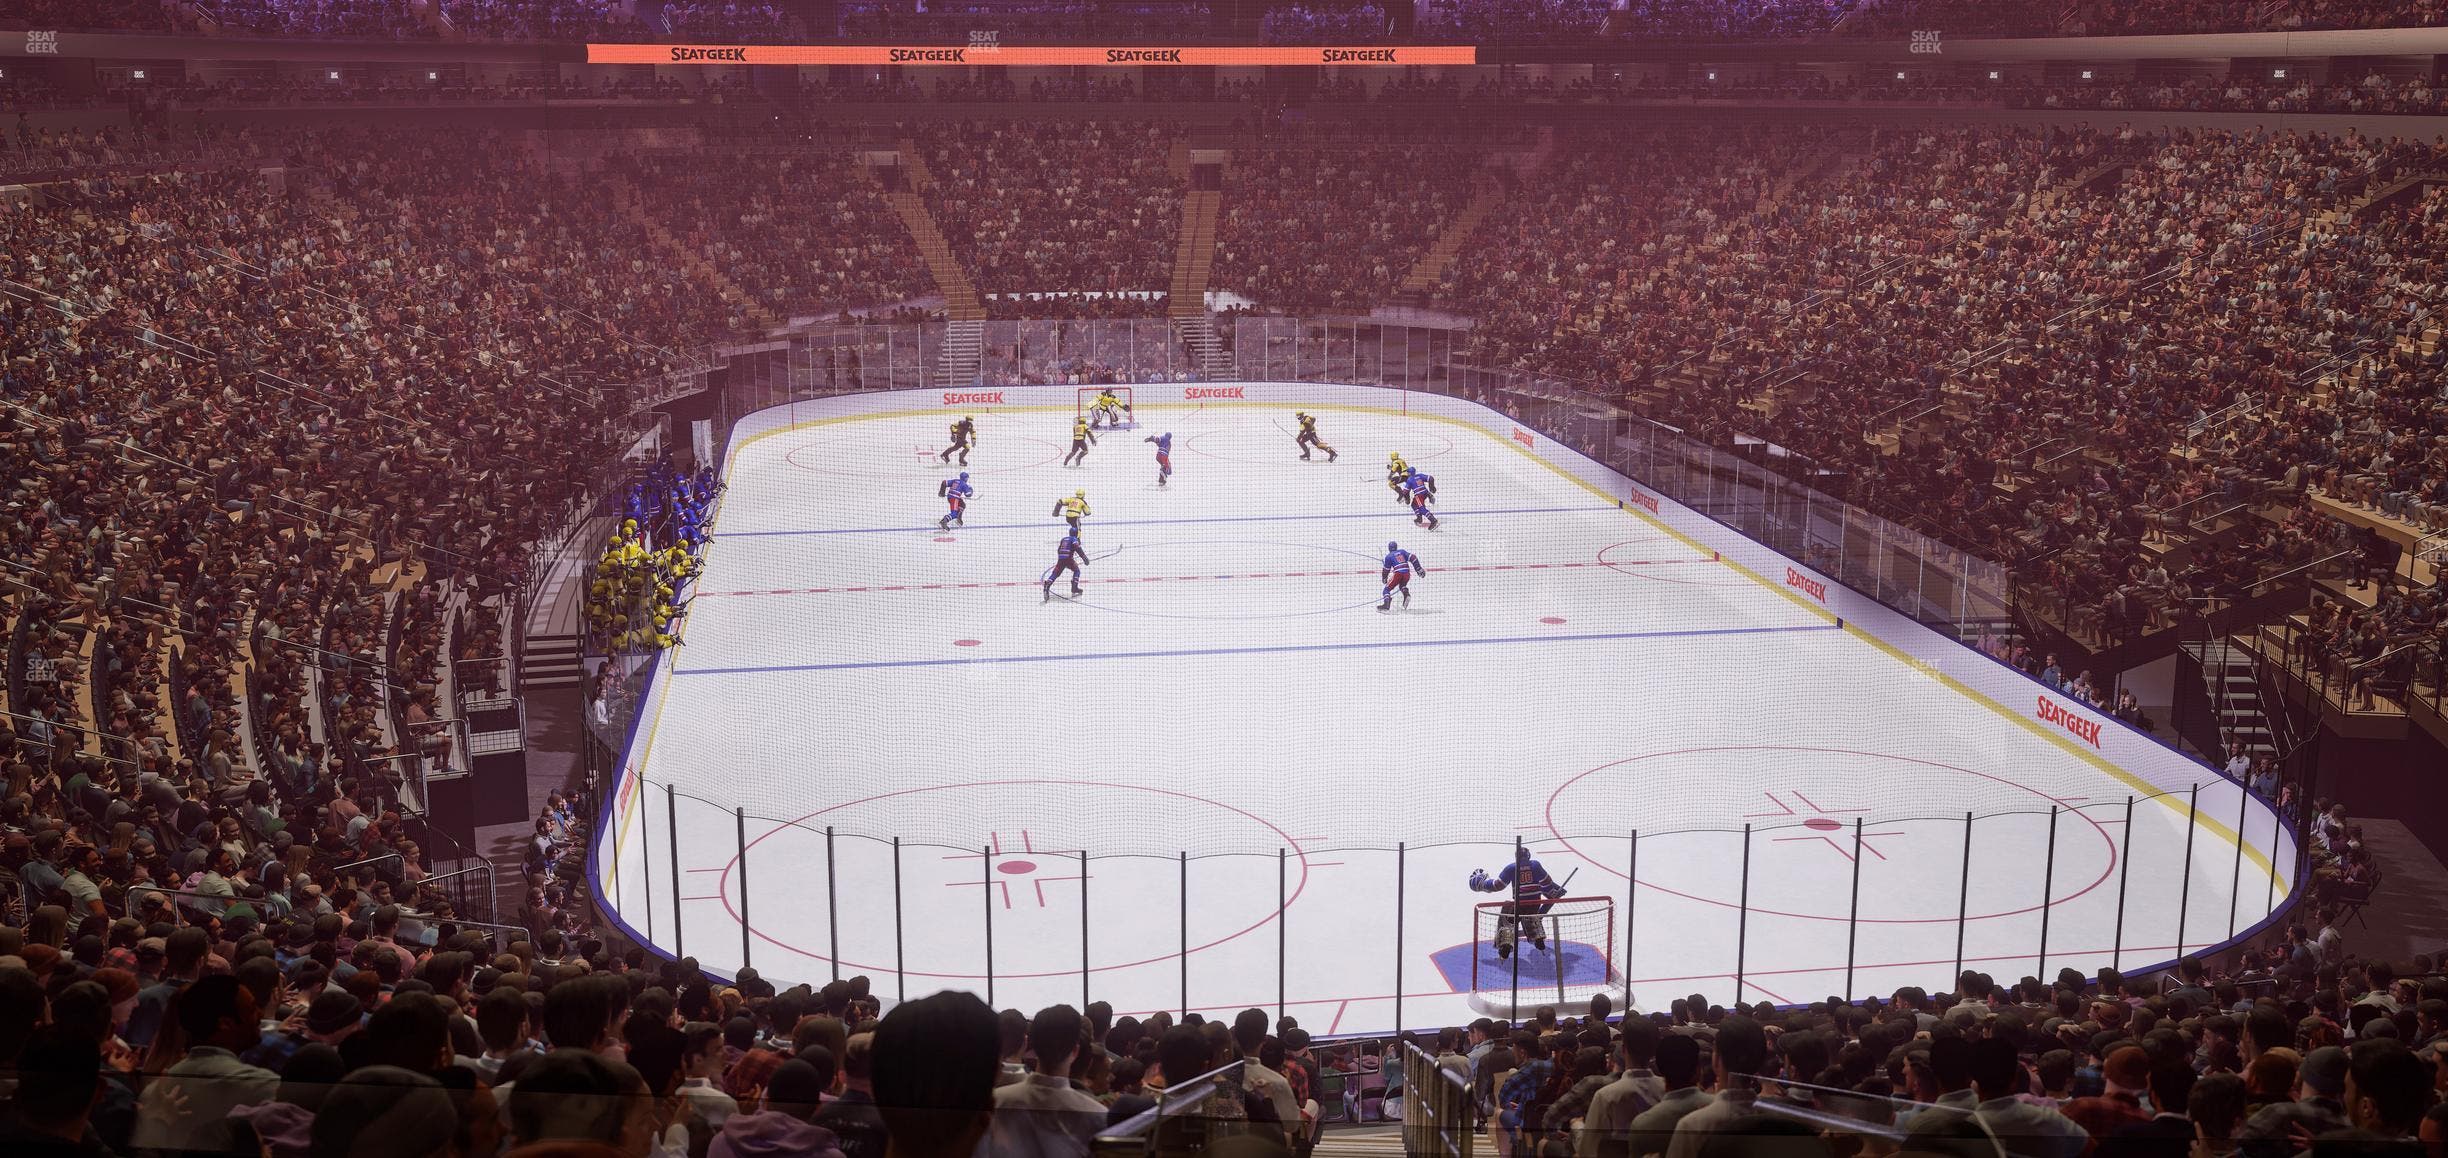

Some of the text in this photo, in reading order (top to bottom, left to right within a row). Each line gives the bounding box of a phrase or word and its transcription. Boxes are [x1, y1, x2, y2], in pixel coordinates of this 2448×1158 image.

[671, 47, 746, 62] SEATGEEK
[889, 48, 965, 63] SEATGEEK
[1106, 49, 1182, 63] SEATGEEK
[1322, 48, 1397, 63] SEATGEEK
[943, 391, 1004, 406] SEATGEEK
[1185, 386, 1244, 400] SEATGEEK
[1630, 486, 1659, 516] SEATGEEK
[1786, 566, 1827, 604] SEATGEEK
[2037, 695, 2102, 750] SEATGEEK
